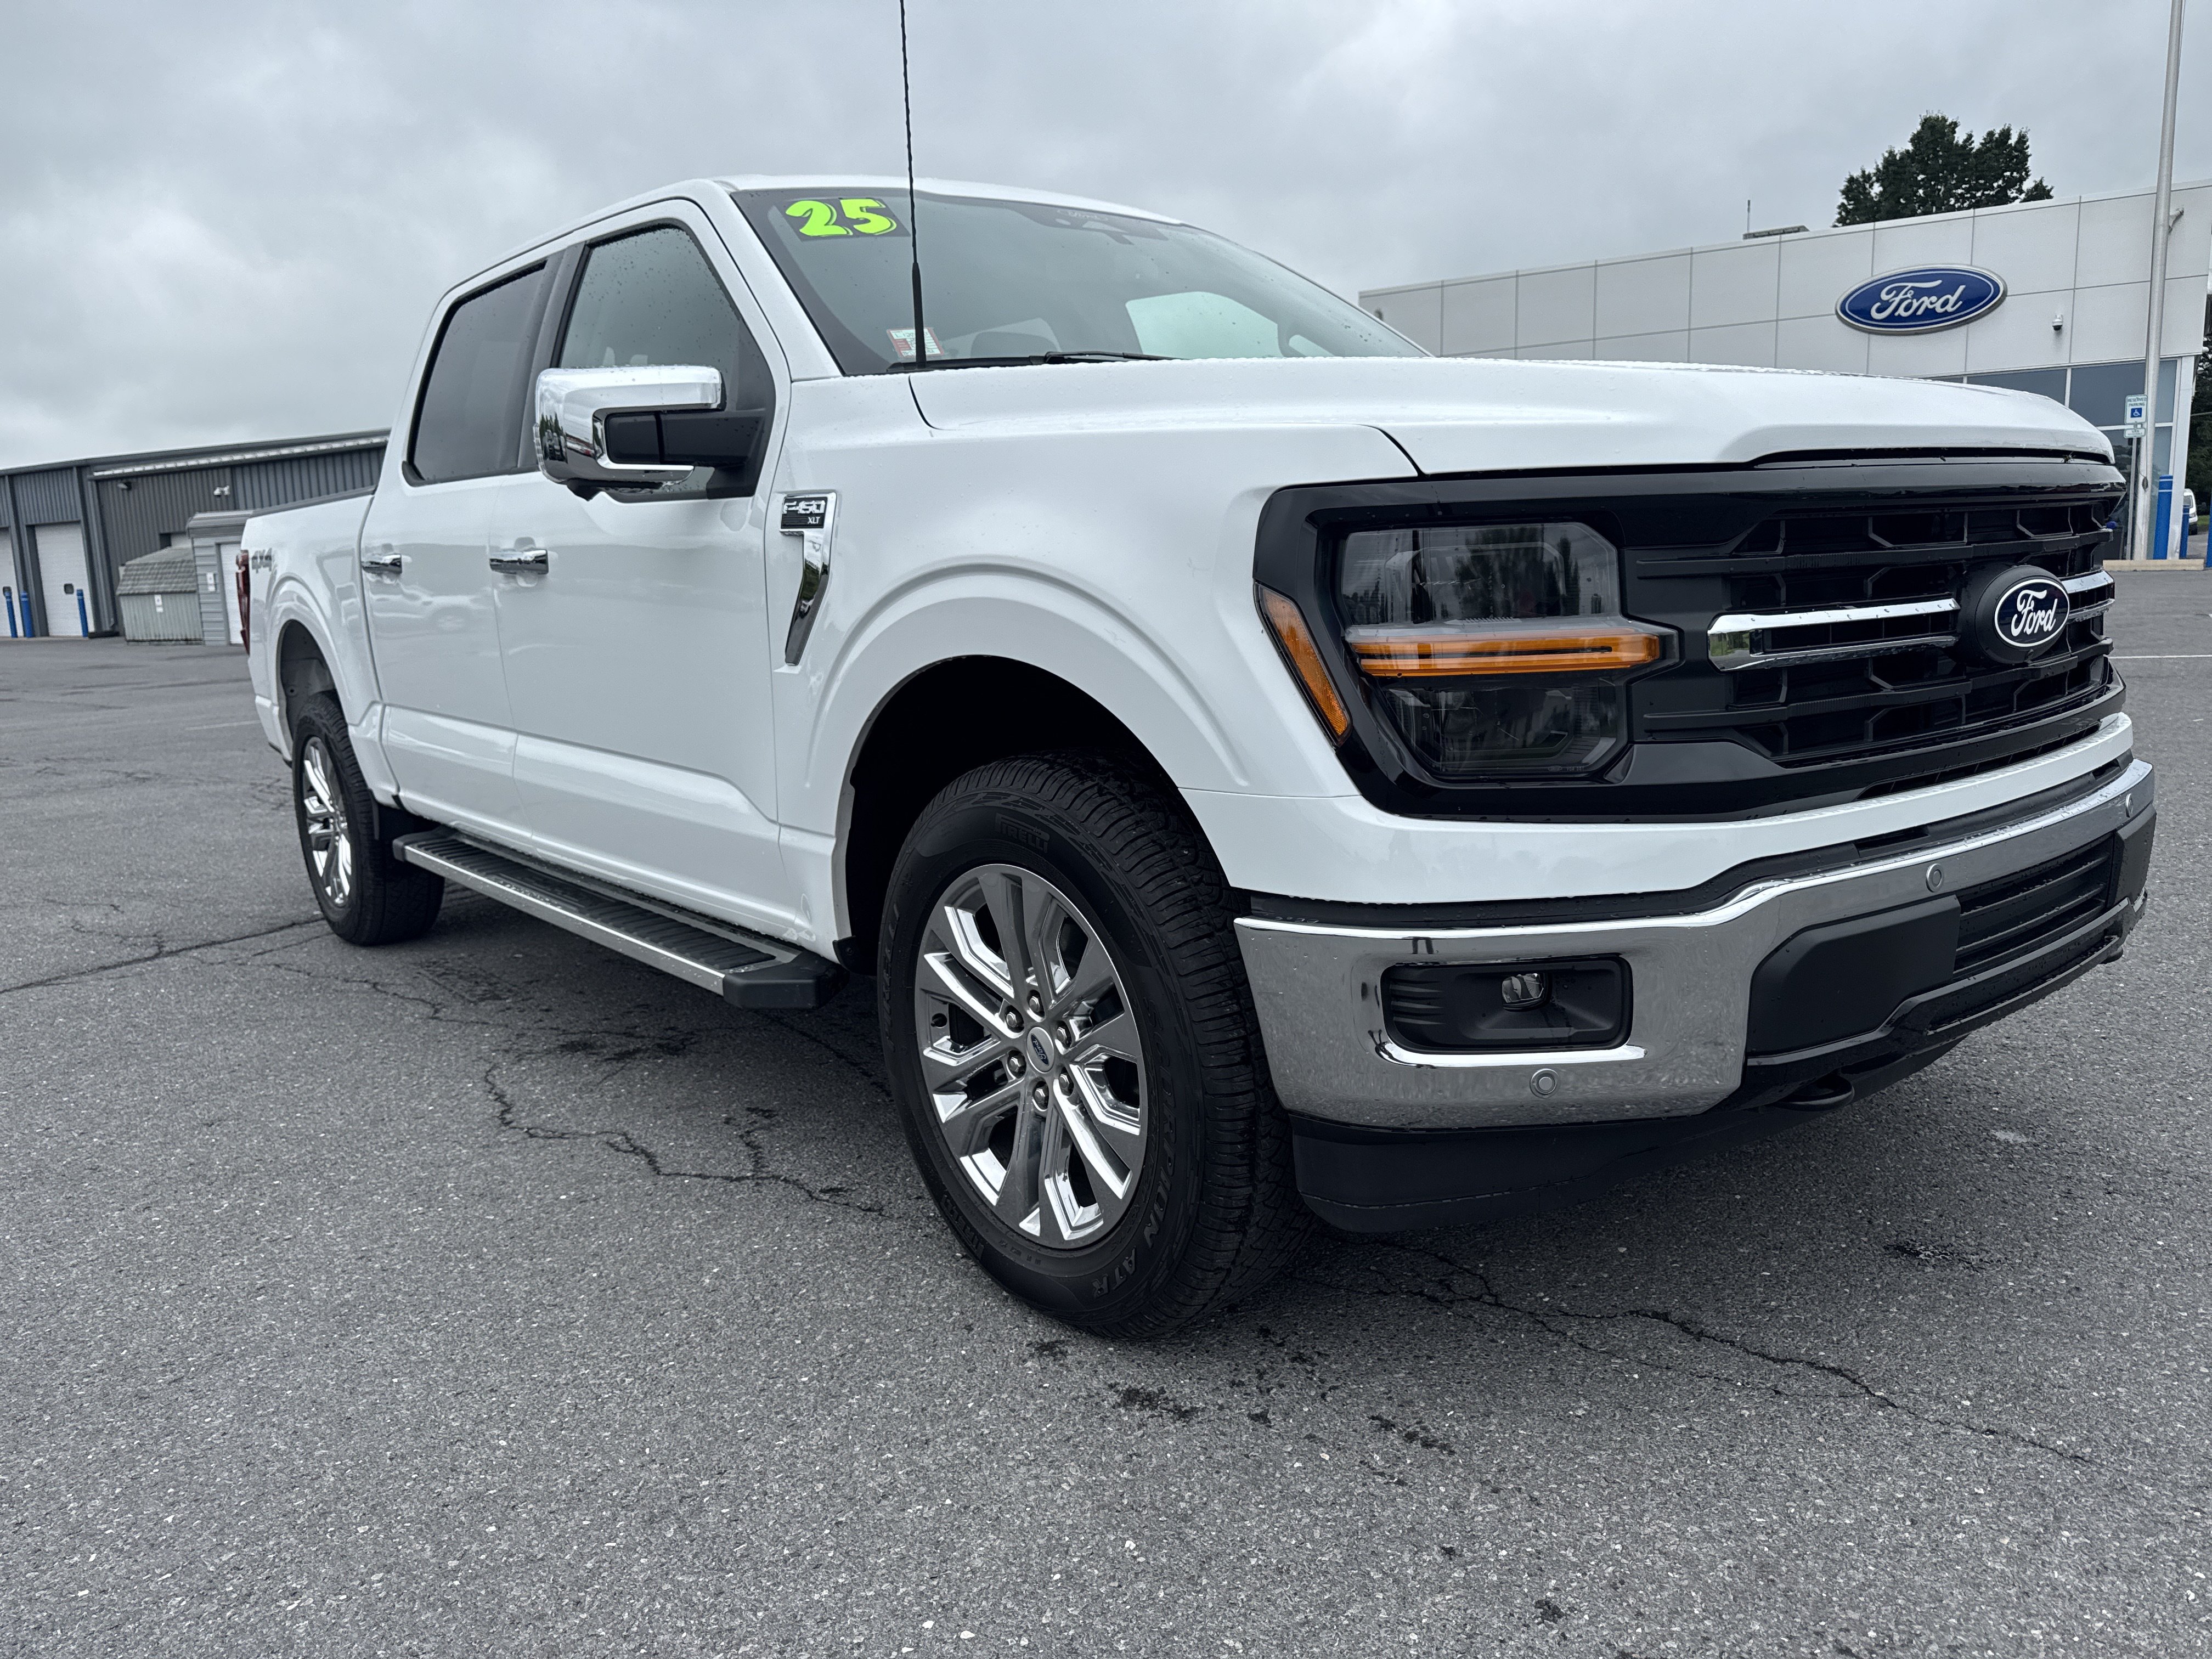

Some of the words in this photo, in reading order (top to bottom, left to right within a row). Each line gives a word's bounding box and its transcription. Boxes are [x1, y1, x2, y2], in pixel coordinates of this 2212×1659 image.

[786, 197, 897, 236] 25
[1870, 280, 1966, 320] Ford
[2011, 589, 2058, 637] Ford
[995, 812, 1050, 854] PIRELLI
[1033, 1039, 1046, 1059] Ford
[1142, 996, 1177, 1249] SCORPION
[1092, 1245, 1137, 1299] ATR
